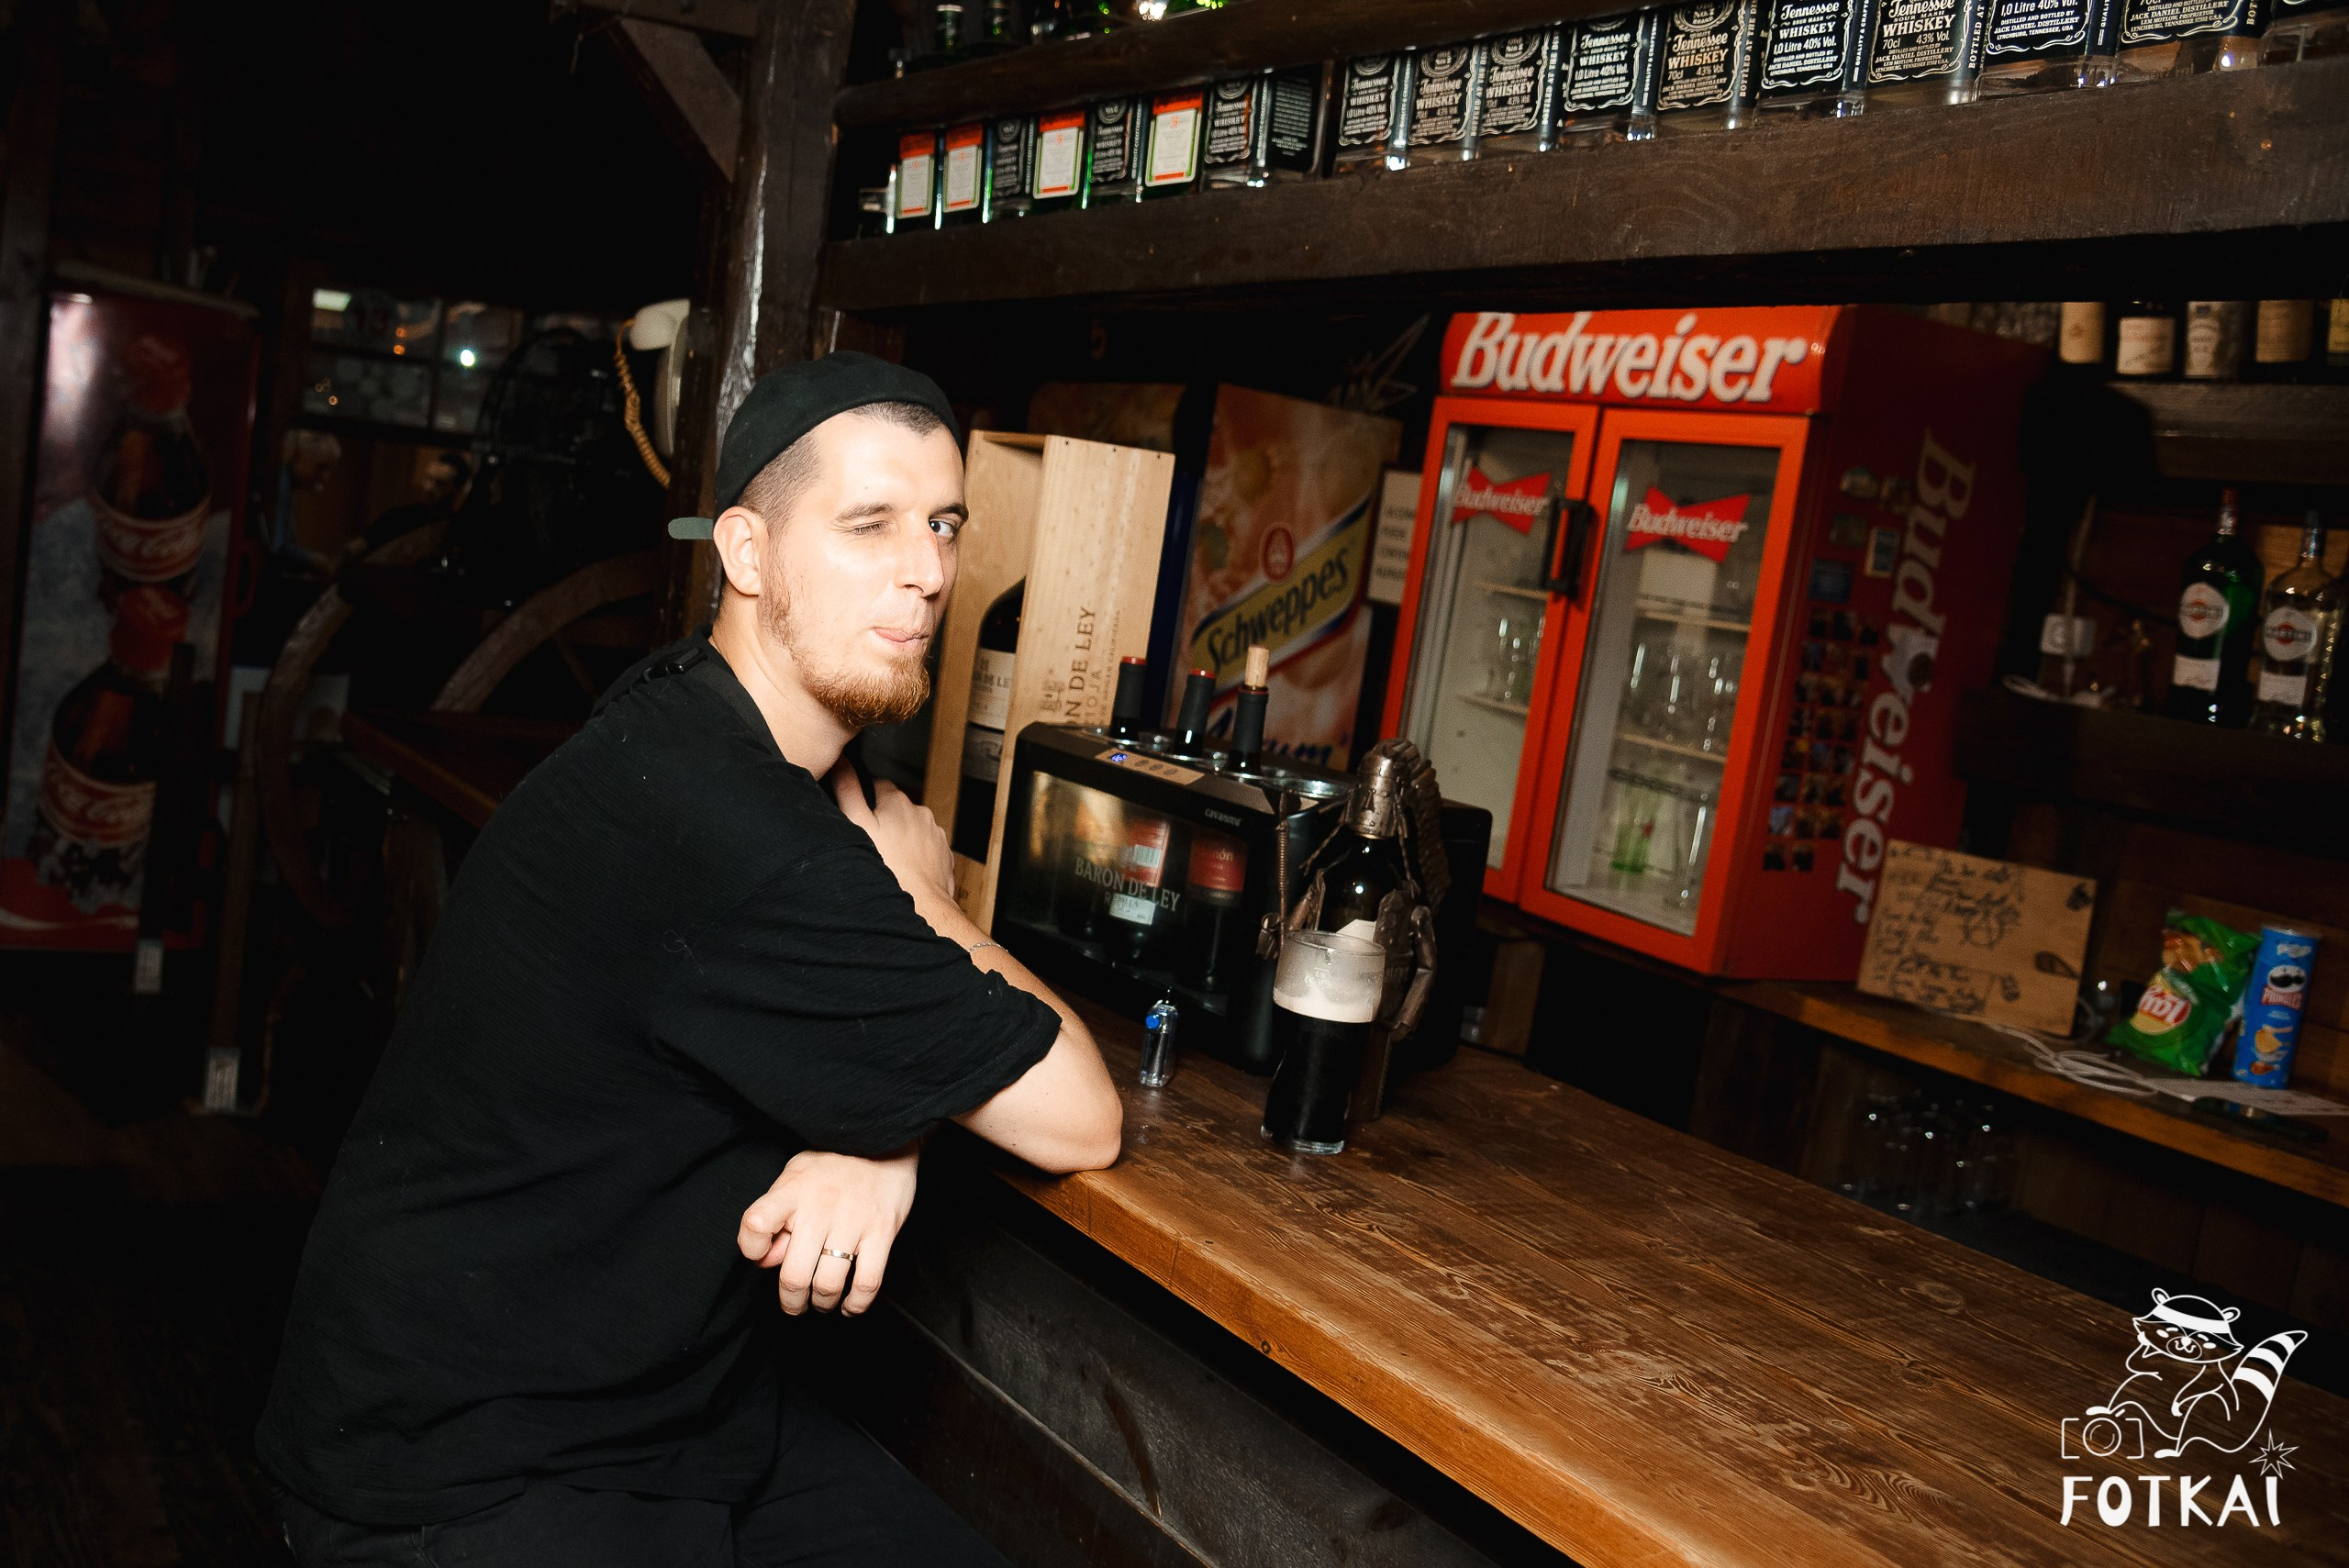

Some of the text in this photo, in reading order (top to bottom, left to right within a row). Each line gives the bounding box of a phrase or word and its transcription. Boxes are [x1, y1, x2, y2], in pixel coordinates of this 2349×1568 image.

[1780, 2, 1839, 20] Tennessee
[1888, 0, 1954, 18] Tennessee
[2014, 1, 2035, 14] Litre
[2130, 1, 2229, 22] JACK DANIEL DISTILLERY
[1883, 14, 1956, 38] WHISKEY
[1894, 15, 1916, 23] SOUR
[1994, 17, 2080, 35] JACK DANIEL DISTILLERY
[2000, 17, 2026, 26] DISTILLED
[2040, 11, 2065, 19] BOTTLED
[2140, 17, 2154, 26] LEM
[1779, 22, 1836, 39] WHISKEY
[2061, 24, 2074, 32] USA
[1580, 32, 1631, 50] Tennessee
[1672, 32, 1729, 53] Tennessee
[1784, 41, 1802, 53] Litre
[1803, 37, 1821, 50] 40%
[1822, 35, 1837, 48] Vol.
[1883, 30, 1950, 50] 70cl 43% Vol.
[1968, 21, 1982, 70] BOTTLED
[1579, 50, 1628, 66] WHISKEY
[1668, 48, 1730, 70] WHISKEY
[1875, 46, 1954, 64] JACK DANIEL DISTILLERY
[1489, 66, 1535, 83] Tennessee
[1350, 92, 1387, 106] WHISKEY
[1486, 81, 1534, 99] WHISKEY
[1416, 92, 1463, 110] WHISKEY
[1452, 312, 1809, 402] Budweiser
[1456, 484, 1552, 516] Budweiser
[1626, 502, 1749, 542] Budweiser
[1207, 545, 1348, 673] Schweppes
[1075, 606, 1096, 651] LEY
[1069, 659, 1089, 690] DE
[1074, 855, 1182, 912] BARON DE LEY
